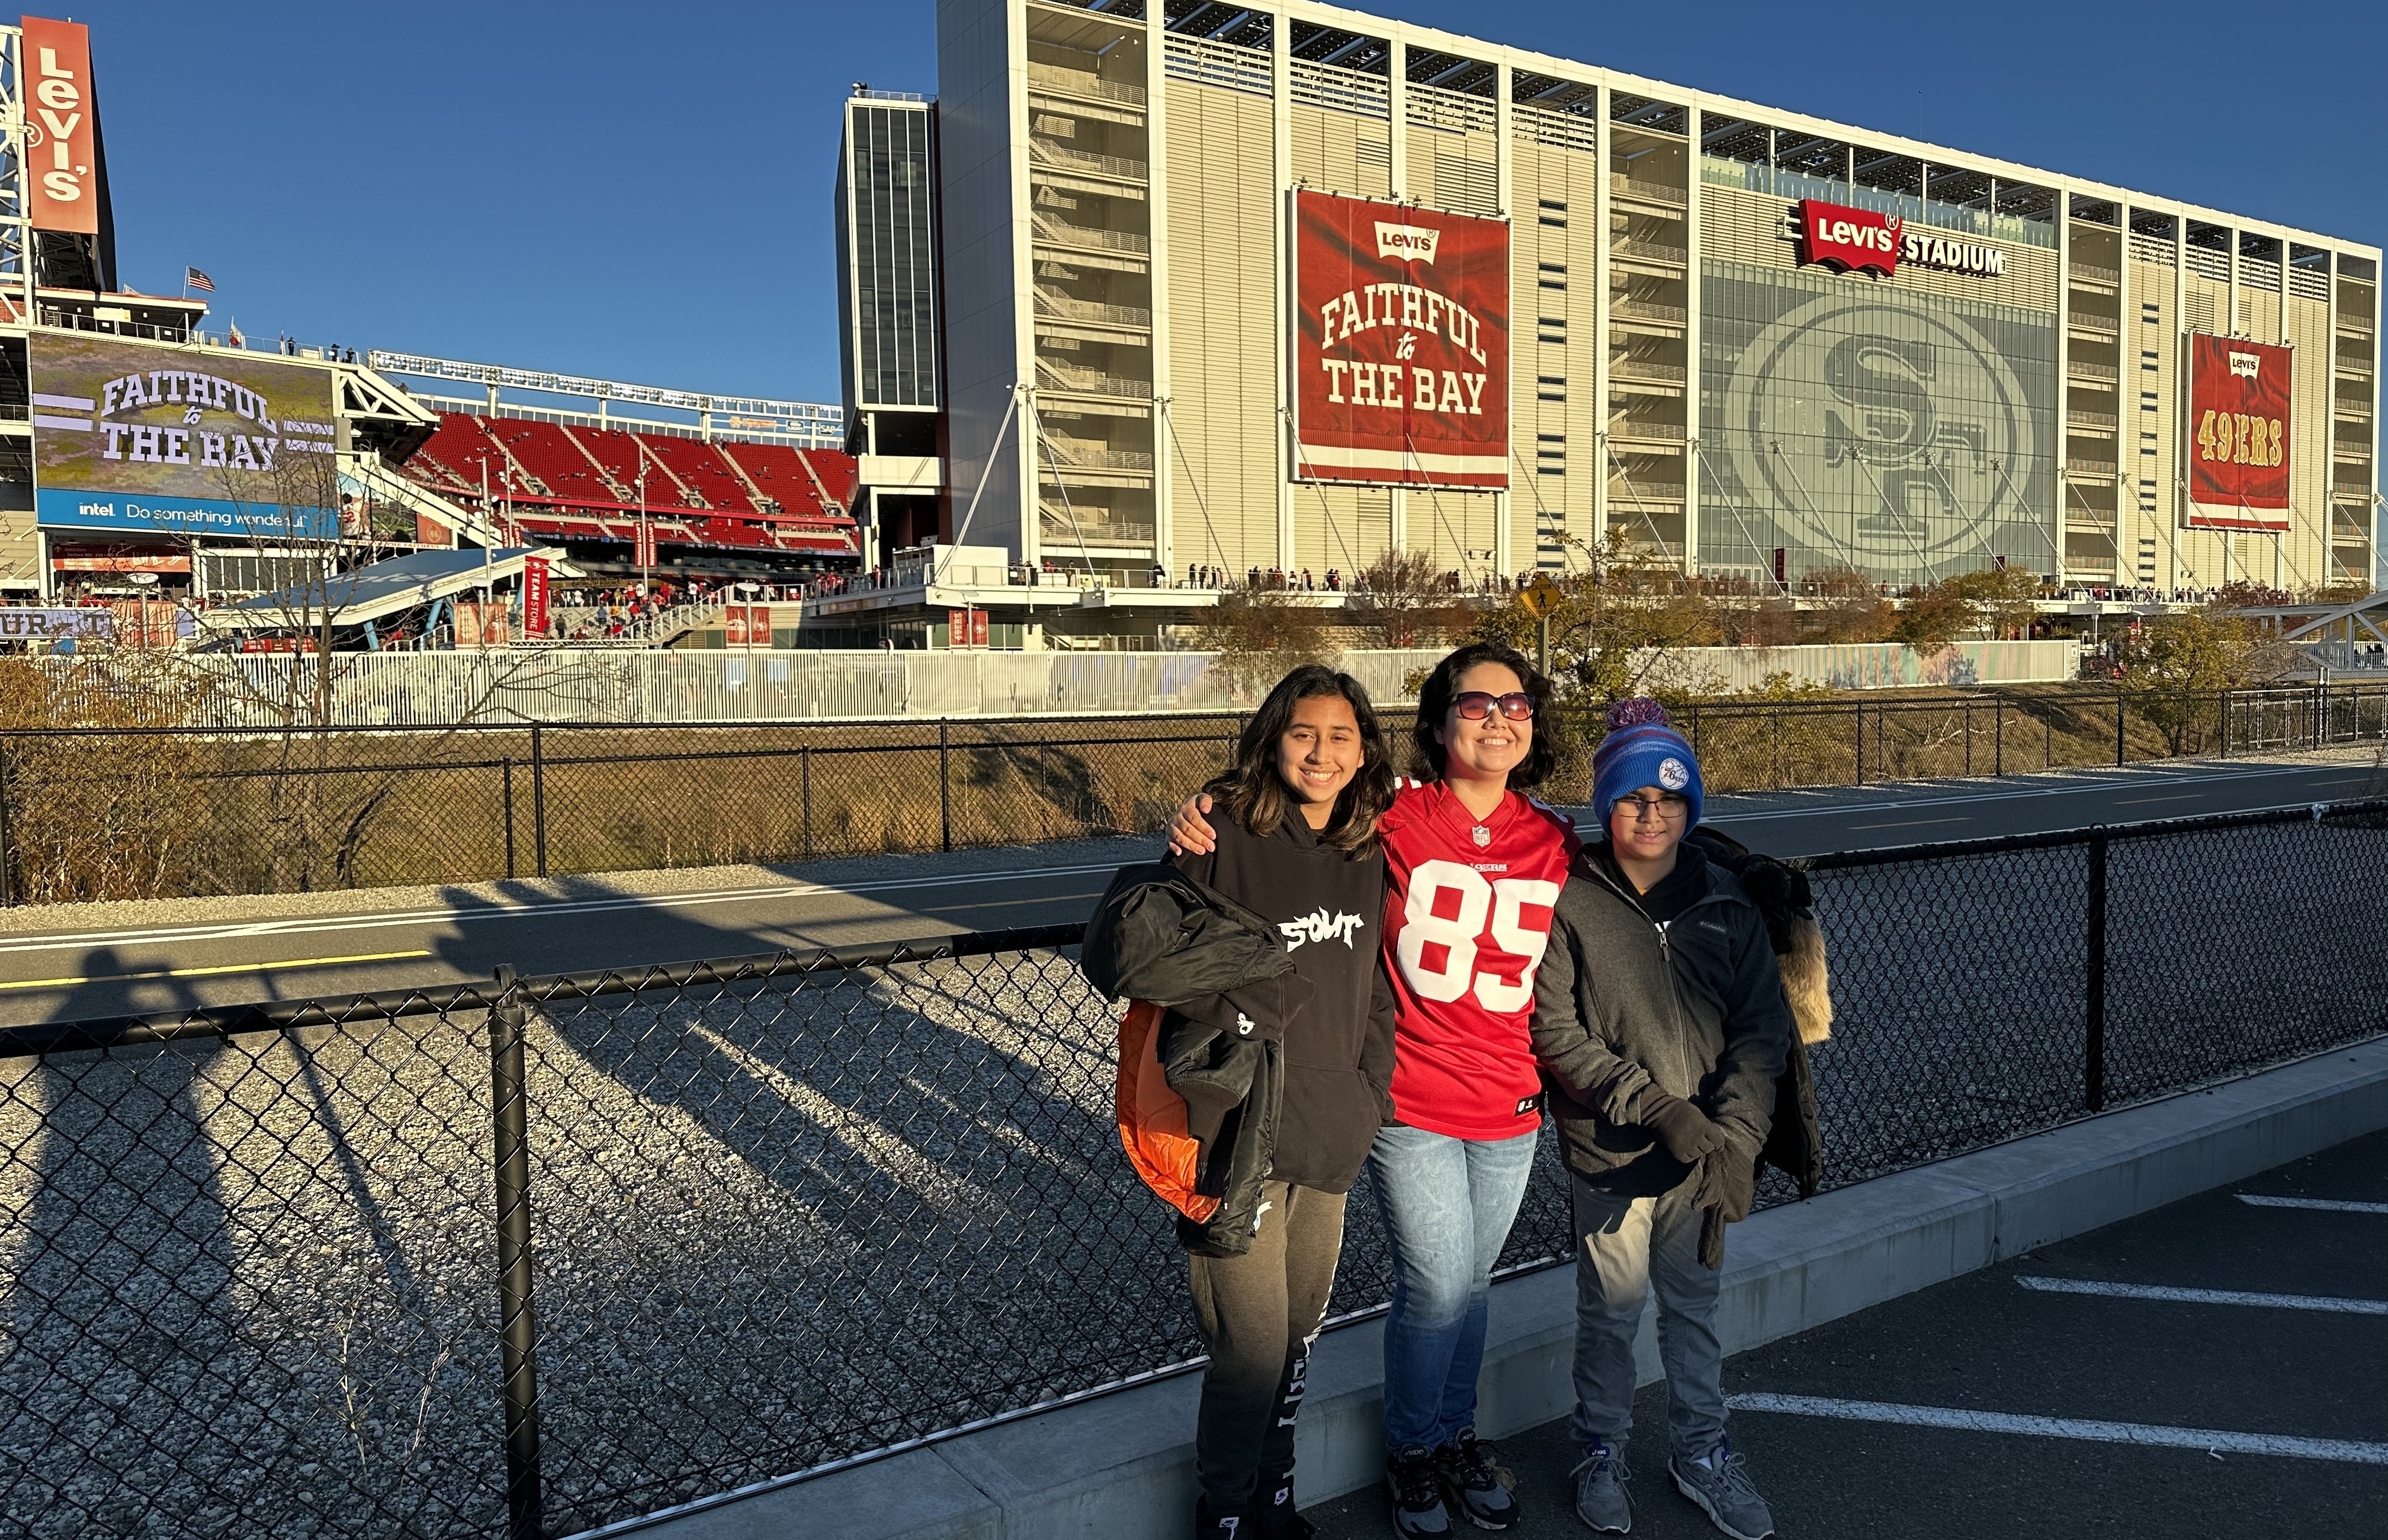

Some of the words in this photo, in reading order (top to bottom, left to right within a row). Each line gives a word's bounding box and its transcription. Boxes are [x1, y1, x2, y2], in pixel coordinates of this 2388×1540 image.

[1905, 233, 2006, 274] STADIUM
[1321, 283, 1487, 368] FAITHFUL
[1395, 331, 1418, 360] to
[1321, 357, 1404, 409] THE
[1412, 366, 1487, 415] BAY
[101, 370, 278, 434] FAITHFUL
[182, 405, 203, 425] to
[820, 425, 836, 433] SAP
[2197, 409, 2283, 467] 49ERS
[100, 422, 190, 465] THE
[200, 431, 279, 472] BAY
[127, 503, 150, 519] Do
[153, 508, 232, 526] something
[531, 572, 540, 601] TEAM
[530, 601, 539, 630] STORE
[1475, 834, 1488, 843] NFL
[1469, 862, 1508, 873] 9ERS
[1397, 859, 1559, 1013] 85
